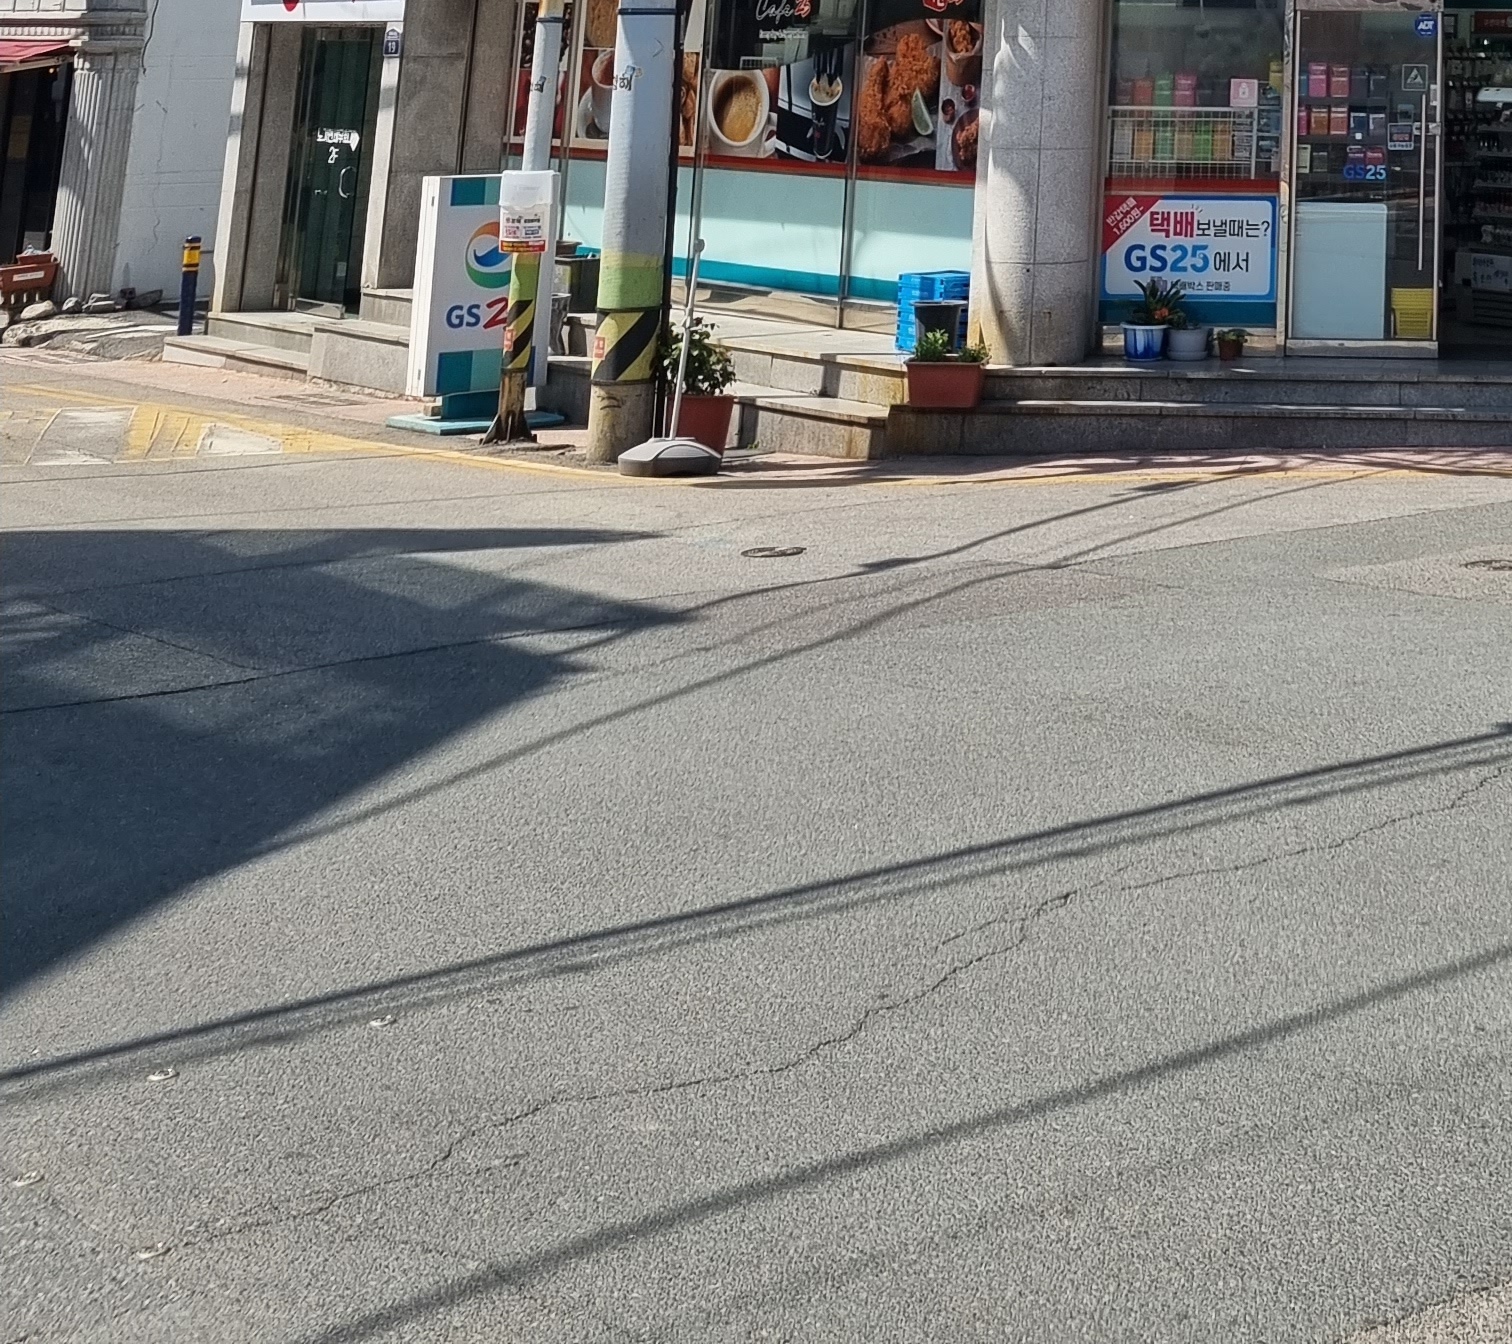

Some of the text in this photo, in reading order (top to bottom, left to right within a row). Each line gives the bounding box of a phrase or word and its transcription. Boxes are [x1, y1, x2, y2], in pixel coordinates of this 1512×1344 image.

[1417, 20, 1435, 31] ADT
[1343, 164, 1387, 180] GS25
[1123, 243, 1251, 274] GS25 에서
[445, 296, 509, 330] GS2
